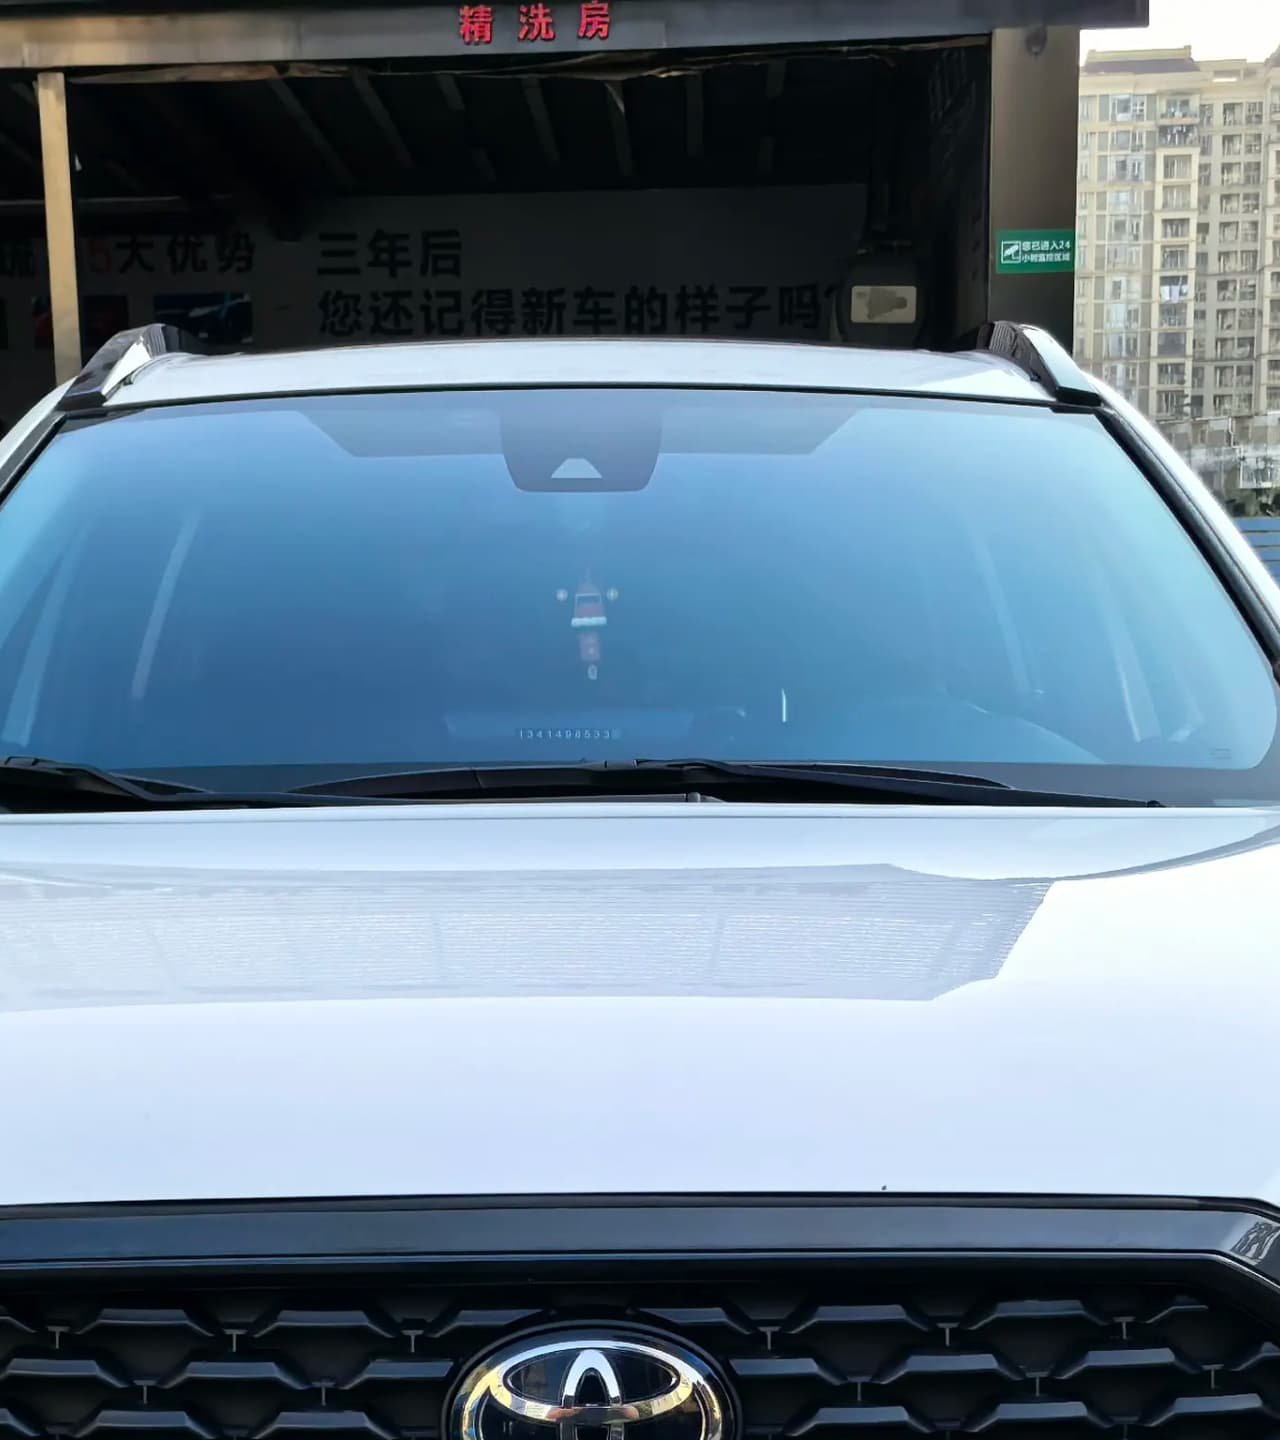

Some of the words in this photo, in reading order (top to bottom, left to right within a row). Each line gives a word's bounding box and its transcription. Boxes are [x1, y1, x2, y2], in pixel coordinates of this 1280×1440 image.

[459, 0, 610, 43] 精洗房
[316, 228, 462, 278] 三年后
